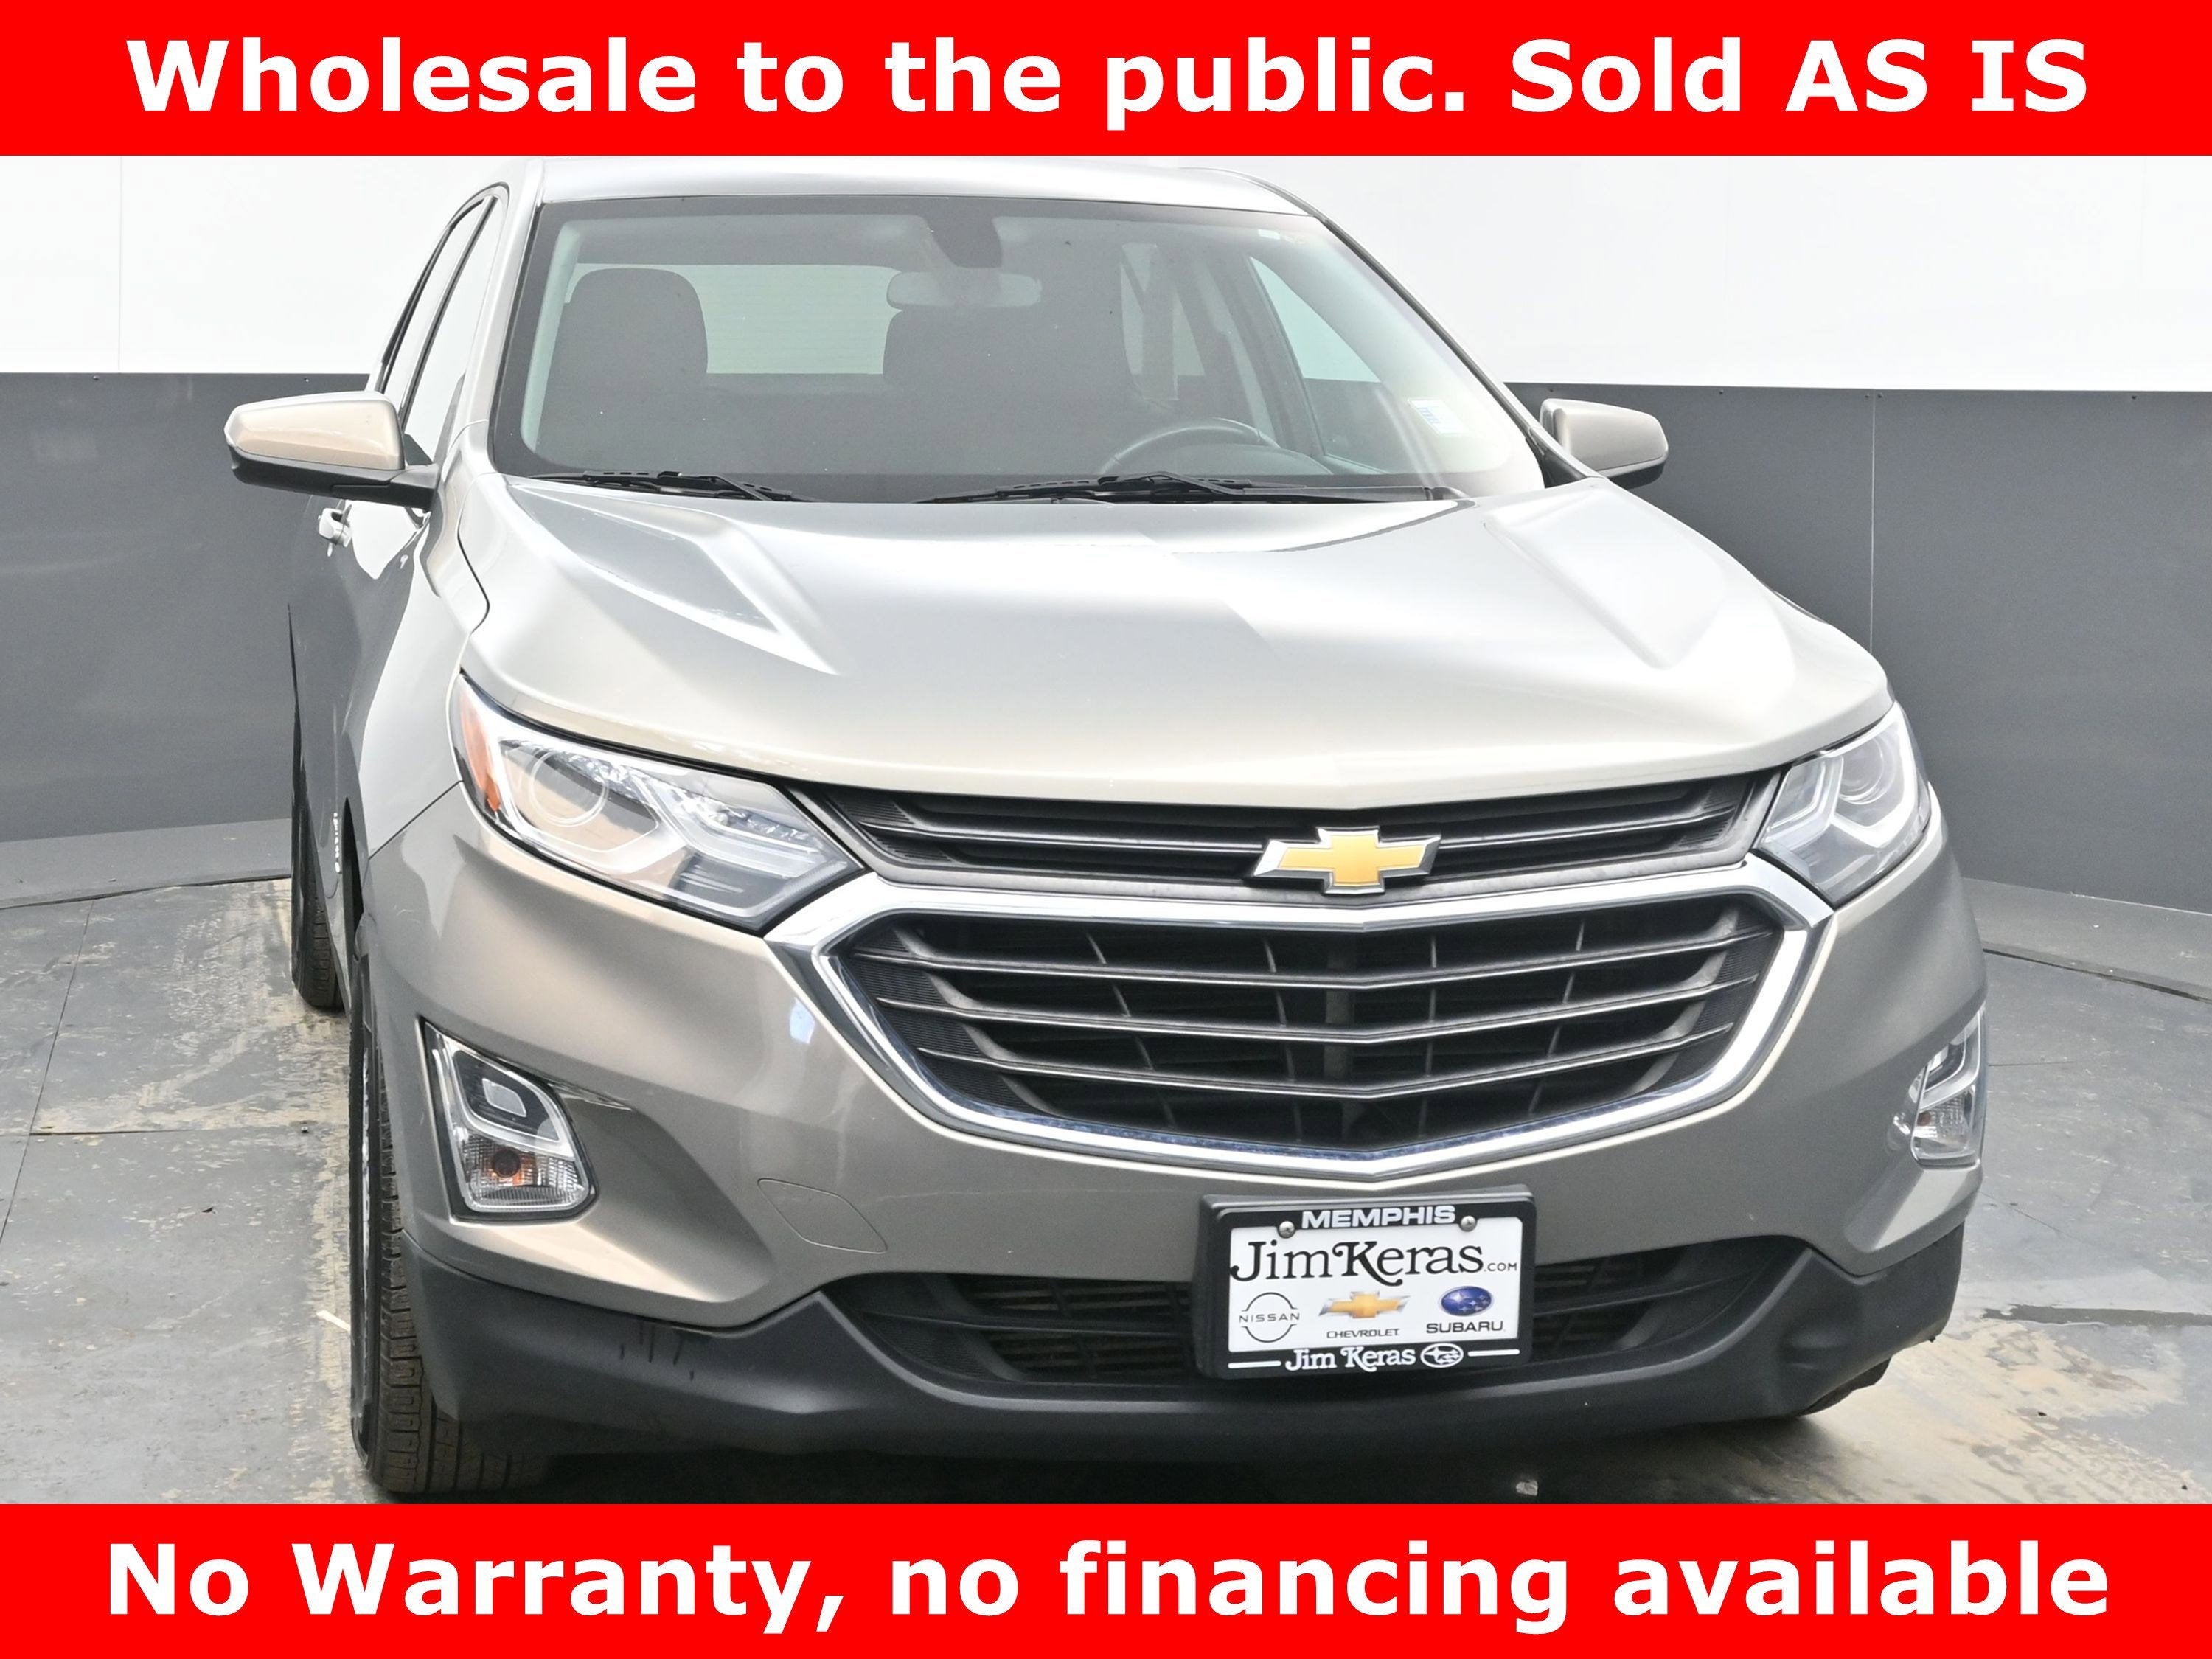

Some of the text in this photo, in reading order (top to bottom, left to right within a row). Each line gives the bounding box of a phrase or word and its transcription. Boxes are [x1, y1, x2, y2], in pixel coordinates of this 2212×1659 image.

[1301, 1206, 1455, 1229] MEMPHIS
[1239, 1312, 1300, 1323] NISSAN
[1326, 1328, 1399, 1339] CHEVROLET
[1426, 1321, 1503, 1334] SUBARU
[1285, 1346, 1416, 1372] Jim Keras
